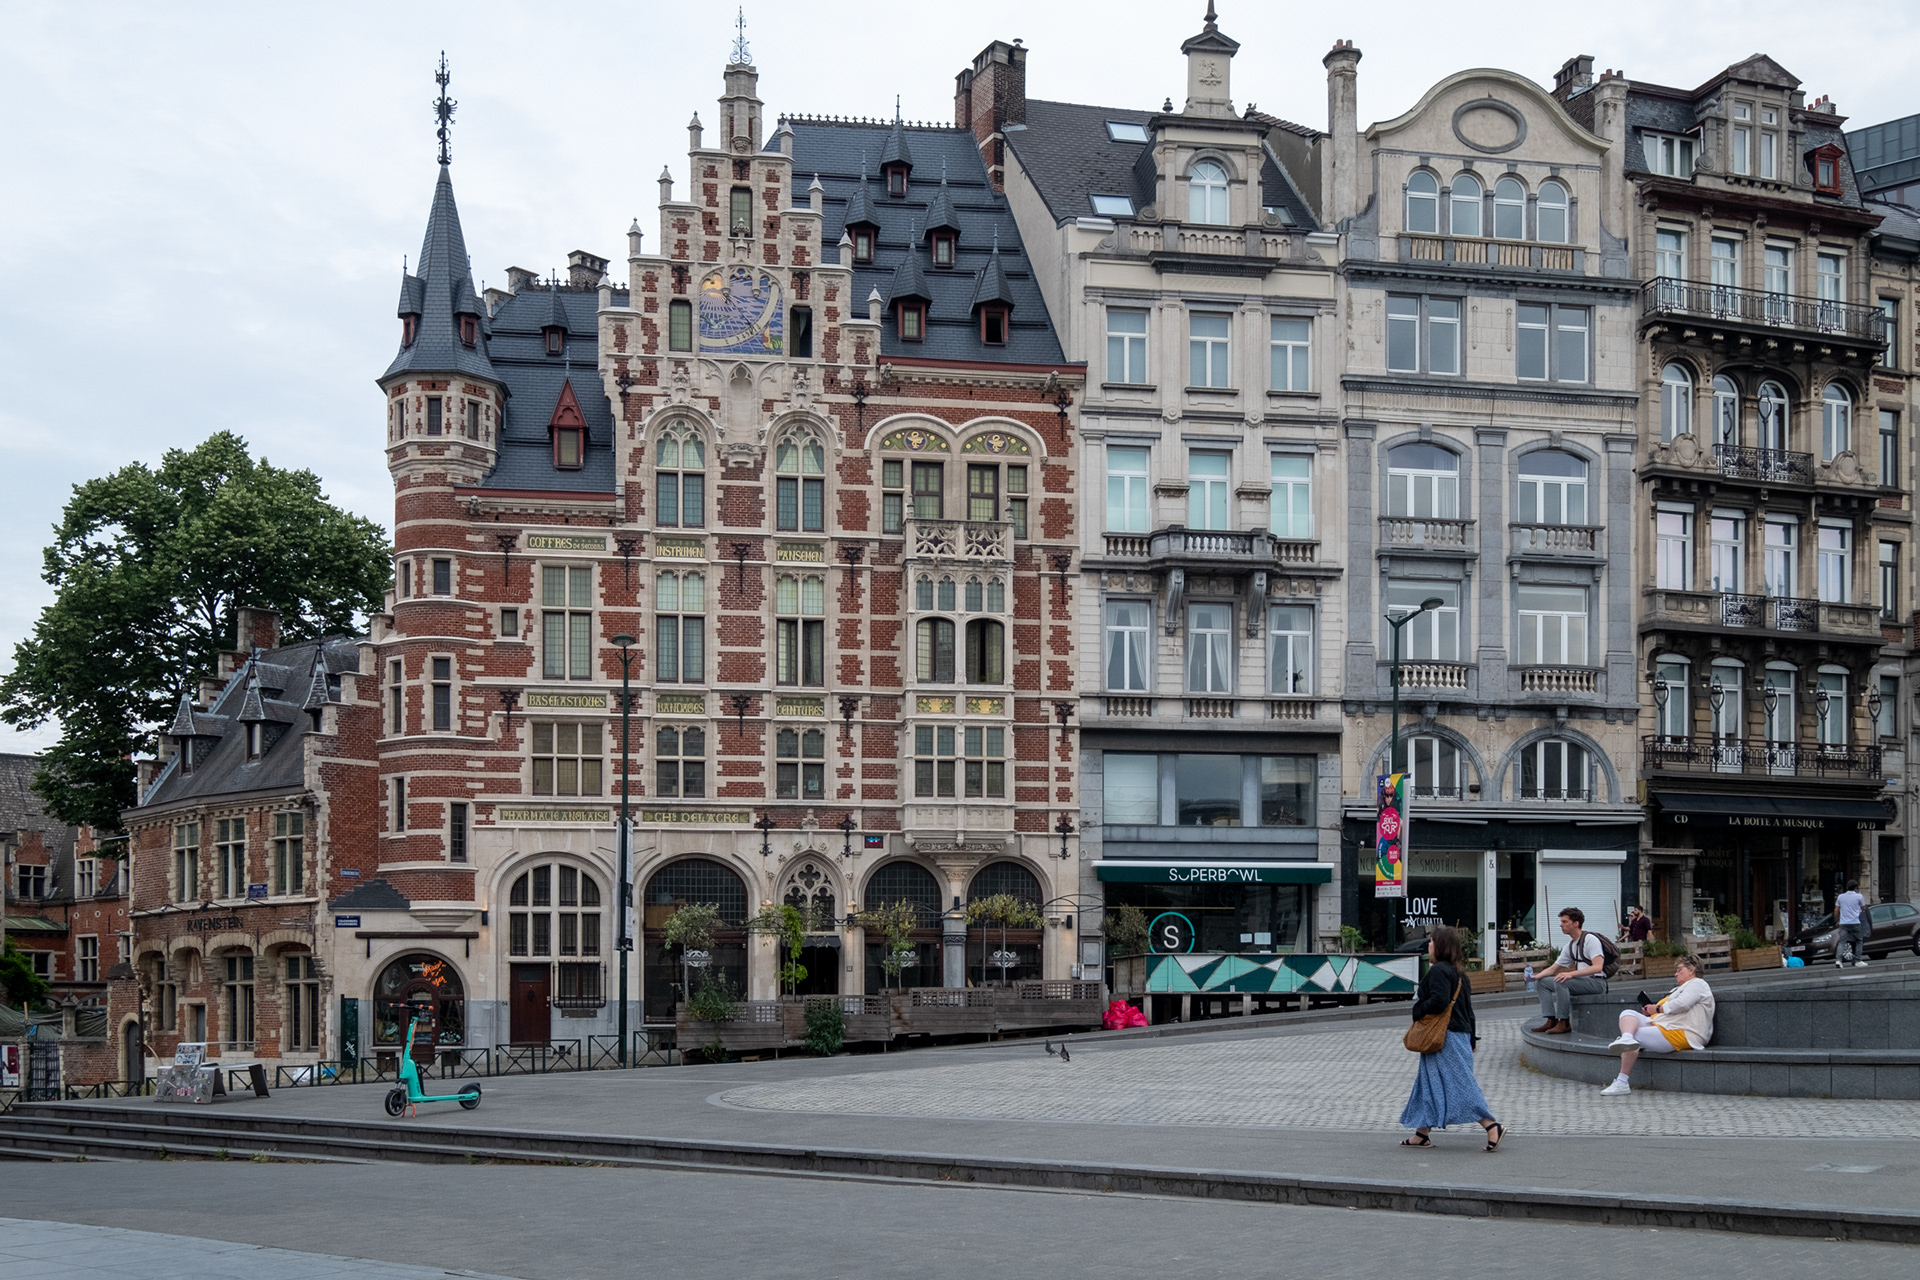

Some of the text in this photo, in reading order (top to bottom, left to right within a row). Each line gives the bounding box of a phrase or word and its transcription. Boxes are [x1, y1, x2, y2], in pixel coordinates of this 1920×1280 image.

[529, 536, 573, 549] COFFRES
[657, 702, 705, 714] BANDAGES
[776, 704, 824, 717] CEINTURES
[502, 810, 609, 821] PHARMACIE ANGLAISE
[681, 812, 739, 823] DELACRE
[1674, 814, 1689, 823] CD
[1729, 816, 1741, 825] LA
[1782, 818, 1825, 829] MUSIQUE
[1857, 821, 1876, 830] DVD
[1420, 857, 1458, 873] SMOOTHIE
[1169, 868, 1263, 882] SUPERBOWL
[1405, 897, 1438, 915] LOVE
[187, 915, 244, 932] RAVENSTEIN
[1163, 925, 1179, 949] S
